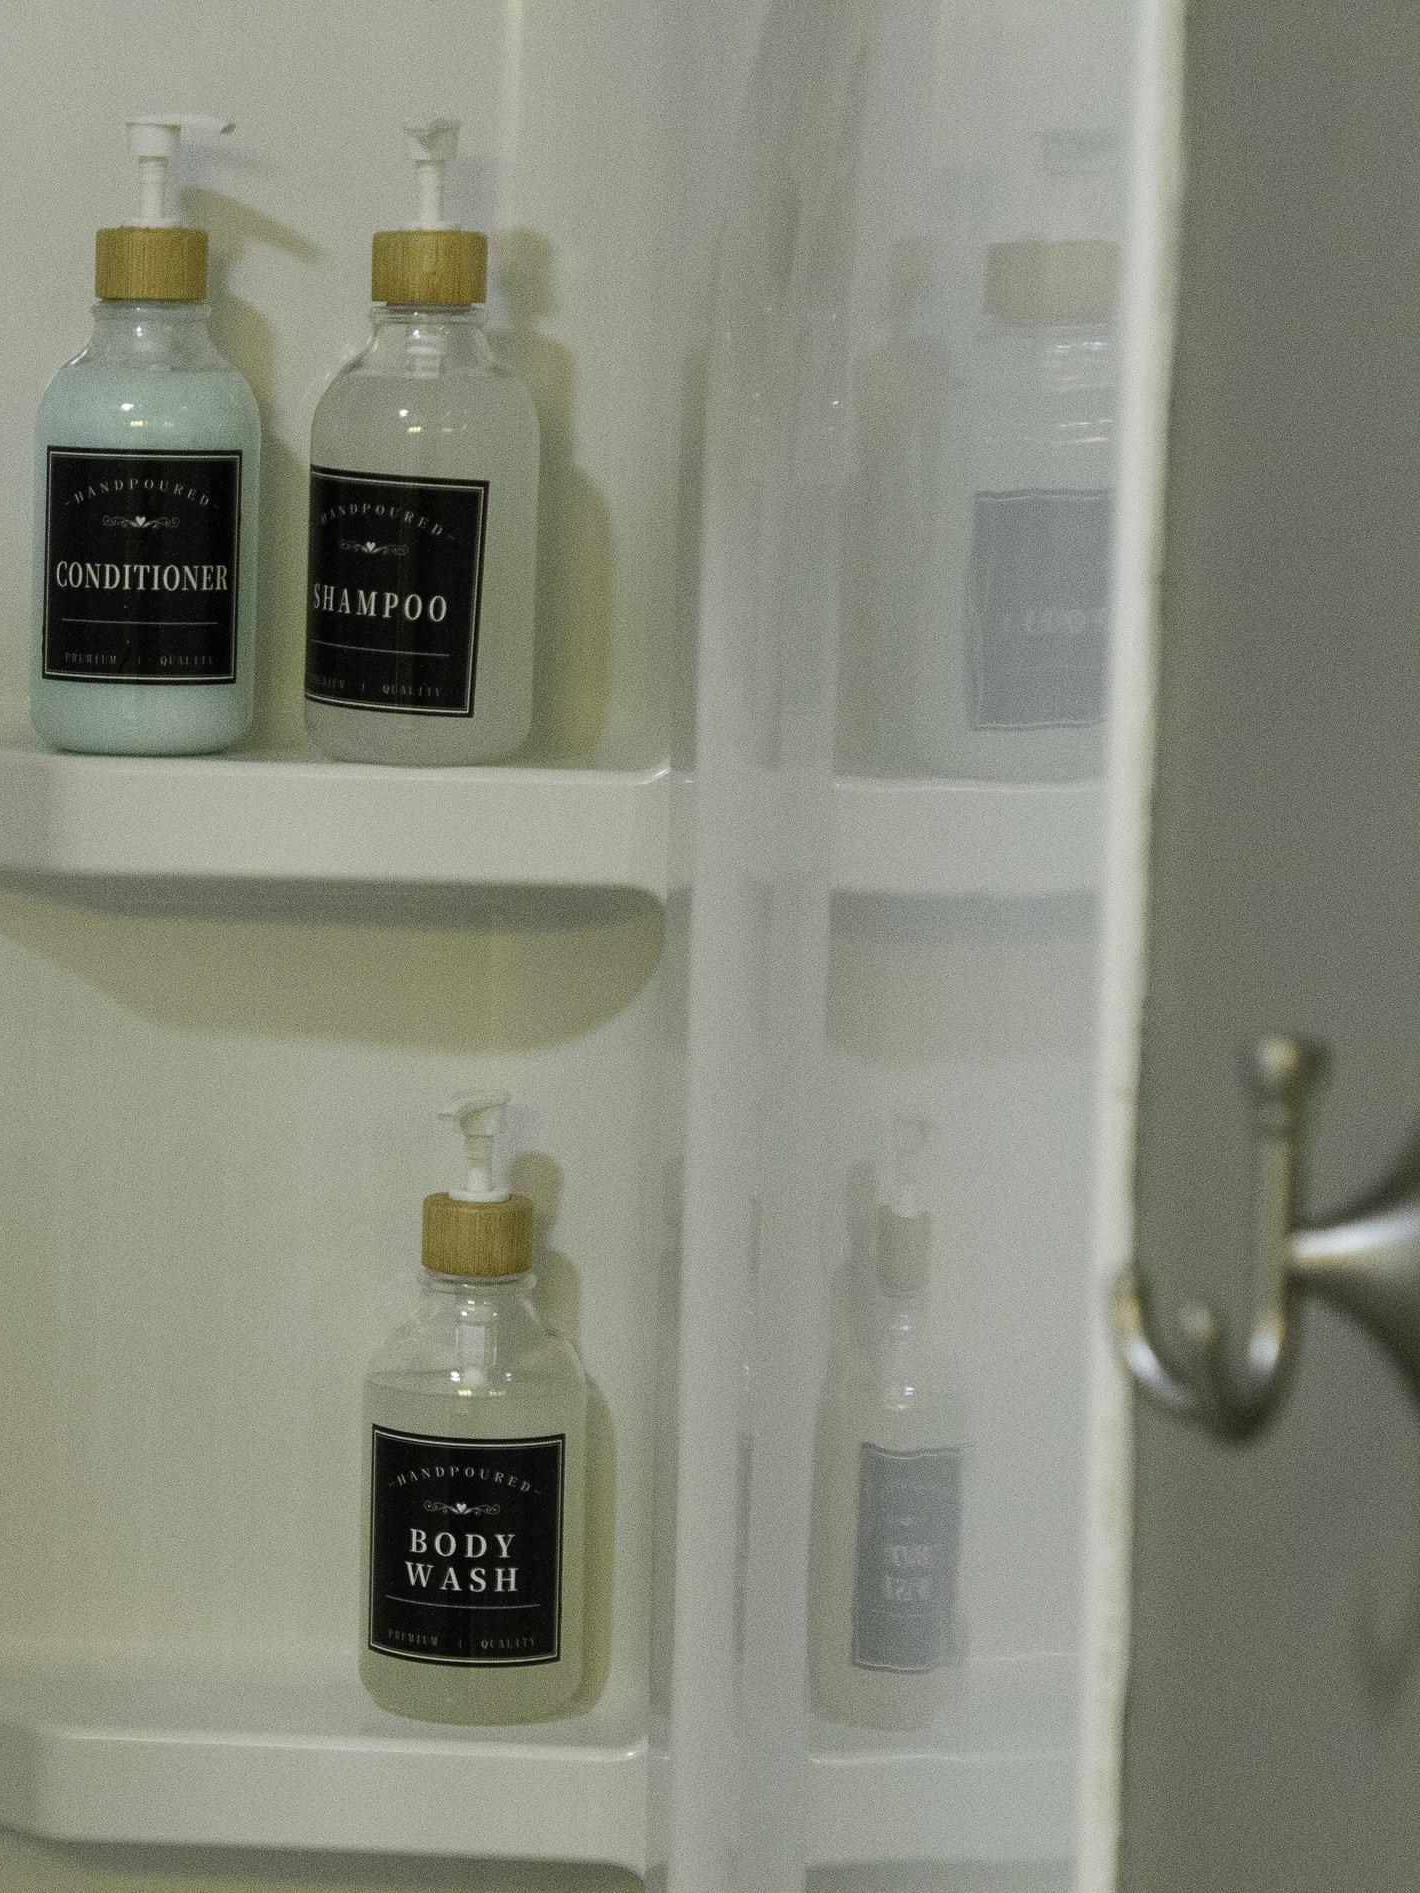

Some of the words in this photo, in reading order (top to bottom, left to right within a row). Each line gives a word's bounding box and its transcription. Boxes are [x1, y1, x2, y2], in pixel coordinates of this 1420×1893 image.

[73, 478, 210, 506] HANDPOURED
[56, 561, 228, 591] CONDITIONER
[313, 582, 447, 622] SHAMPOO
[64, 652, 117, 665] PREMIUM
[159, 655, 214, 667] QUALITY
[382, 683, 441, 698] QUALITY
[397, 1466, 531, 1492] HANDPOURED
[409, 1528, 516, 1558] BODY
[405, 1561, 518, 1593] WASH
[481, 1636, 535, 1650] QUALITY
